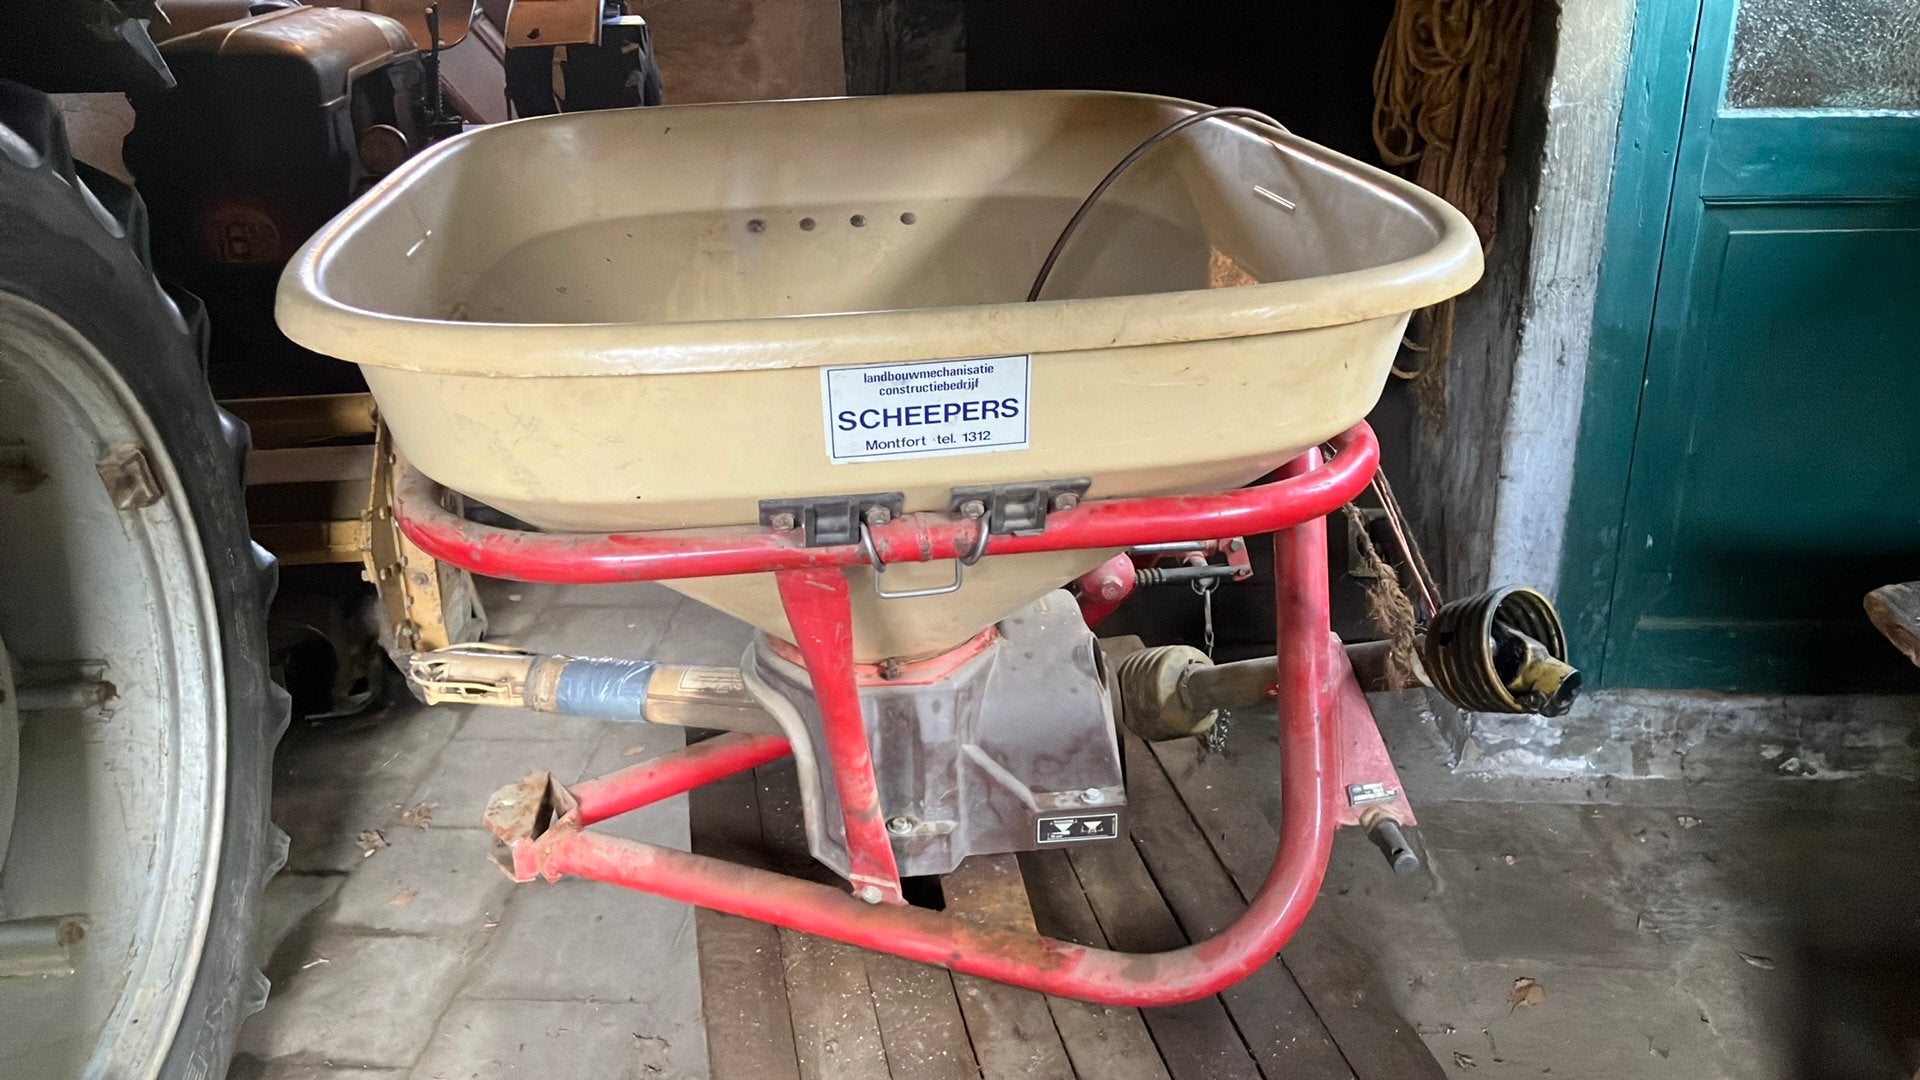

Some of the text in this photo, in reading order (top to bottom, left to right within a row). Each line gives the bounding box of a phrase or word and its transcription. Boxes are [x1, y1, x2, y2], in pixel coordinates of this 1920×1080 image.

[863, 363, 994, 384] landbouwmechanisatie
[879, 378, 980, 396] constructiebedrijf
[838, 398, 1019, 431] SCHEEPERS
[865, 430, 991, 451] Montfort tel. 1312
